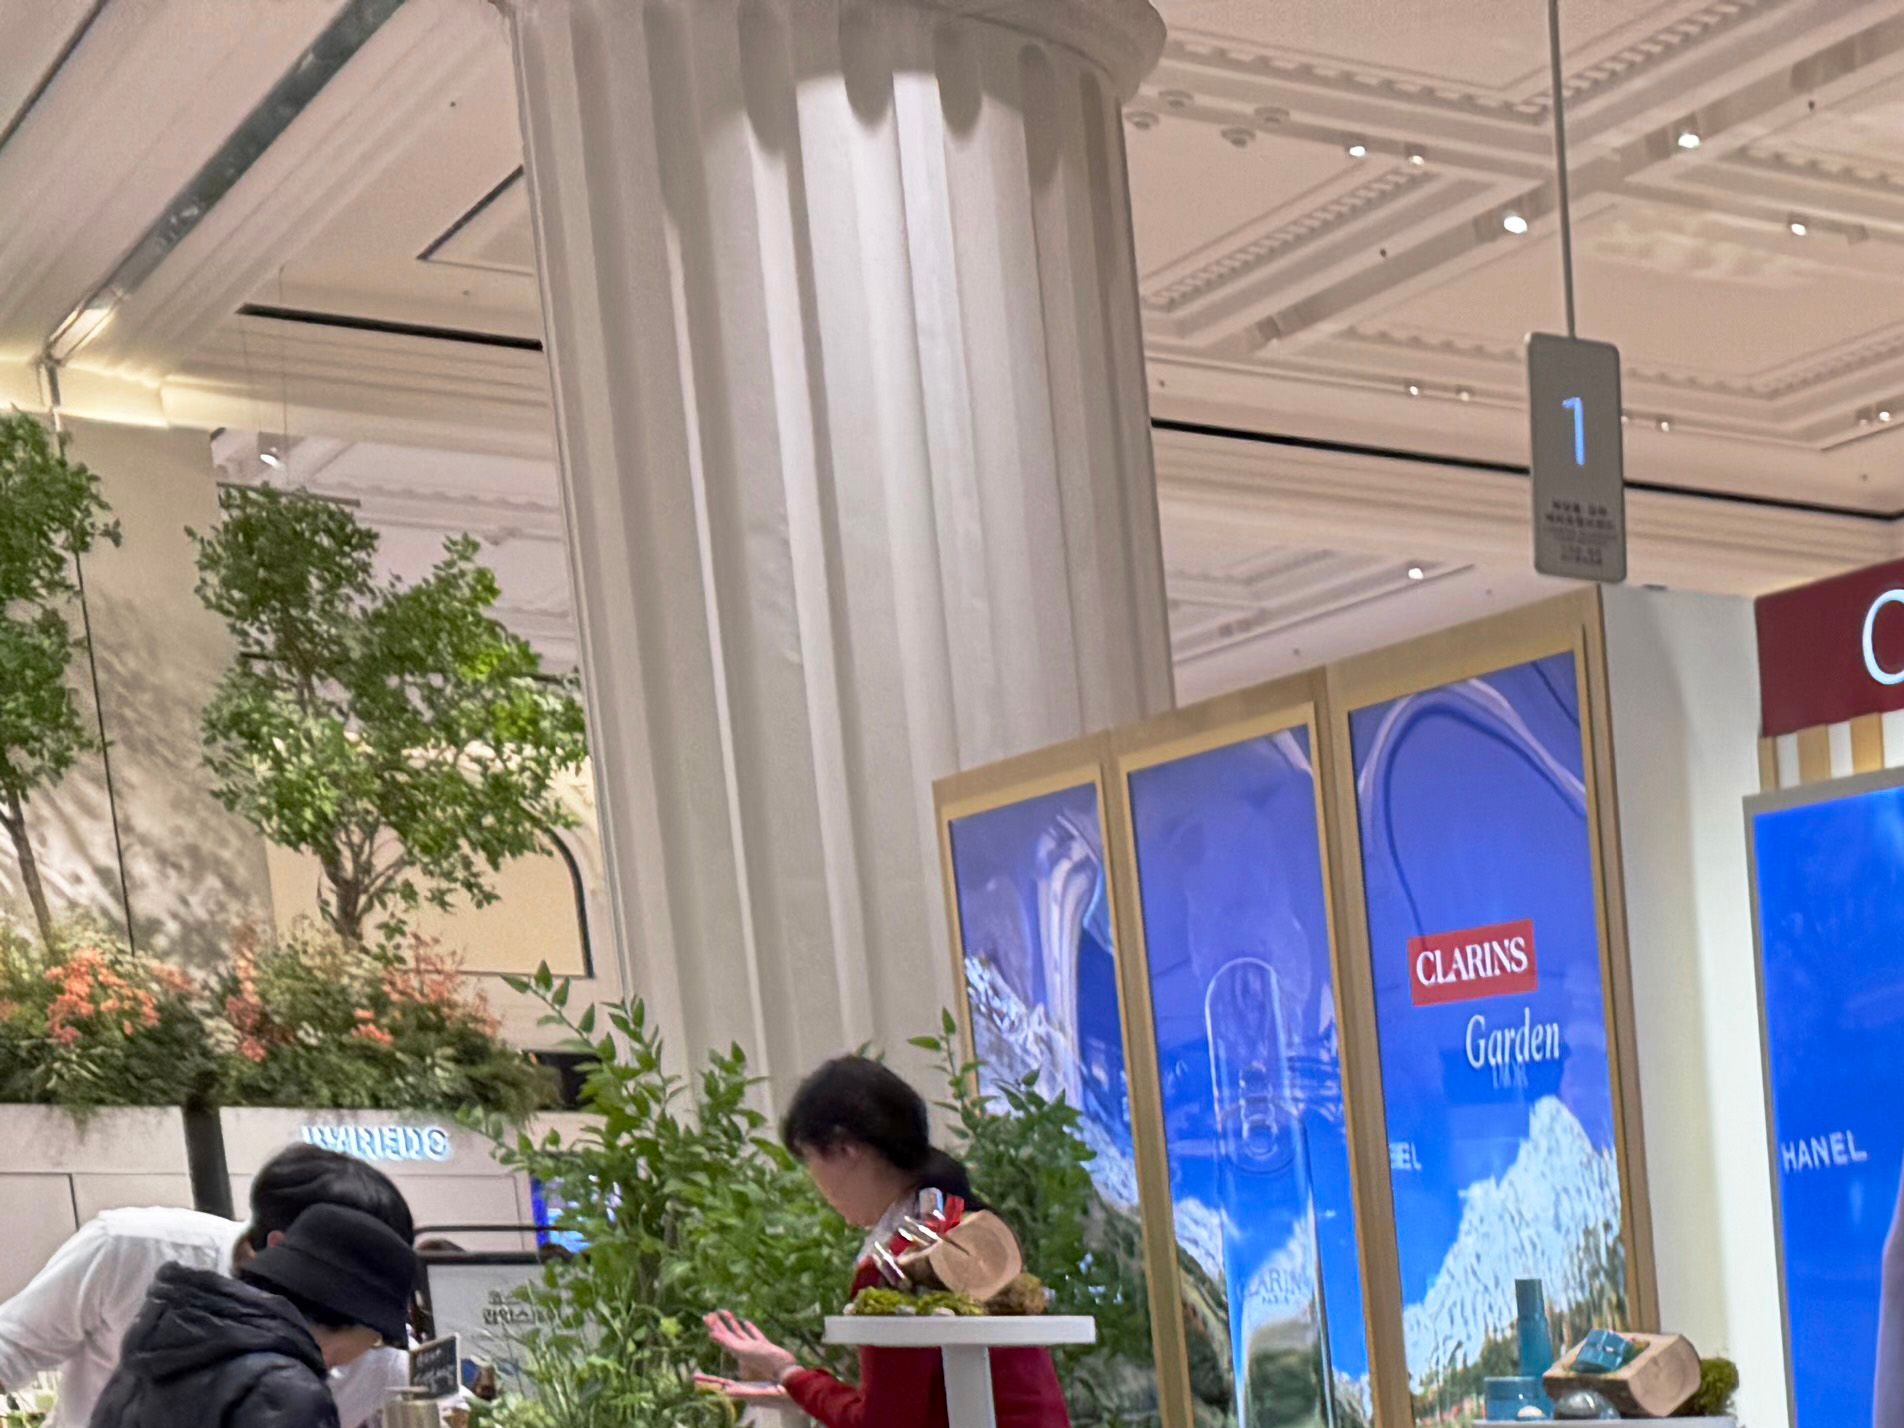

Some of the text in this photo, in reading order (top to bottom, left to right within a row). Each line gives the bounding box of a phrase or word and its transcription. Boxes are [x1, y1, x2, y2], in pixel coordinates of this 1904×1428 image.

[1561, 396, 1586, 467] 1
[1415, 936, 1529, 988] CLARINS
[1465, 1006, 1560, 1070] Garden
